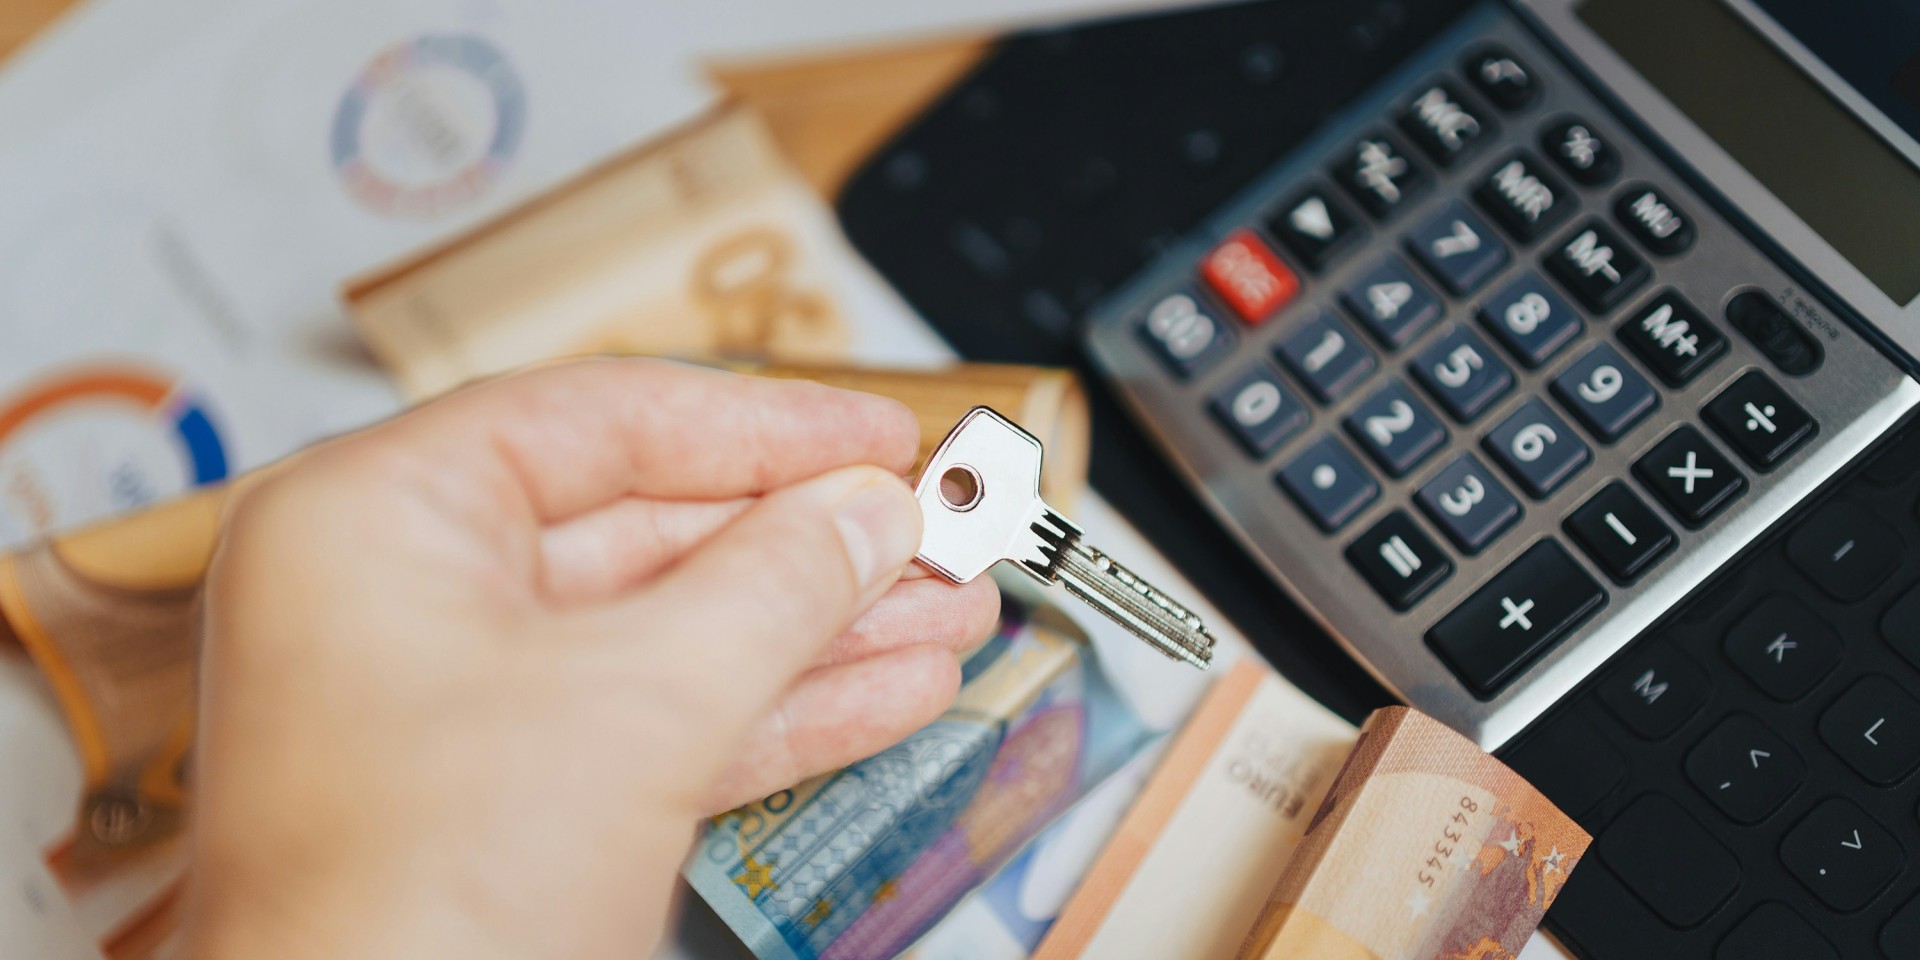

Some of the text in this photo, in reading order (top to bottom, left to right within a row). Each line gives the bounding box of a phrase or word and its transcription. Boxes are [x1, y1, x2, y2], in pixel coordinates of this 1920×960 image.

[1493, 161, 1554, 222] MR
[1432, 219, 1481, 258] 7
[1367, 281, 1413, 320] 4
[1505, 292, 1551, 336] 8
[1304, 329, 1346, 373] 1
[1642, 303, 1697, 357] M+
[1434, 344, 1484, 388] 5
[1578, 365, 1623, 403] 9
[1232, 381, 1281, 427] 0
[1365, 399, 1415, 447] 2
[1511, 423, 1557, 462] 6
[1439, 474, 1485, 516] 3
[1766, 632, 1798, 663] K
[1634, 669, 1669, 704] M
[1864, 718, 1885, 746] L
[1417, 796, 1478, 889] 843345
